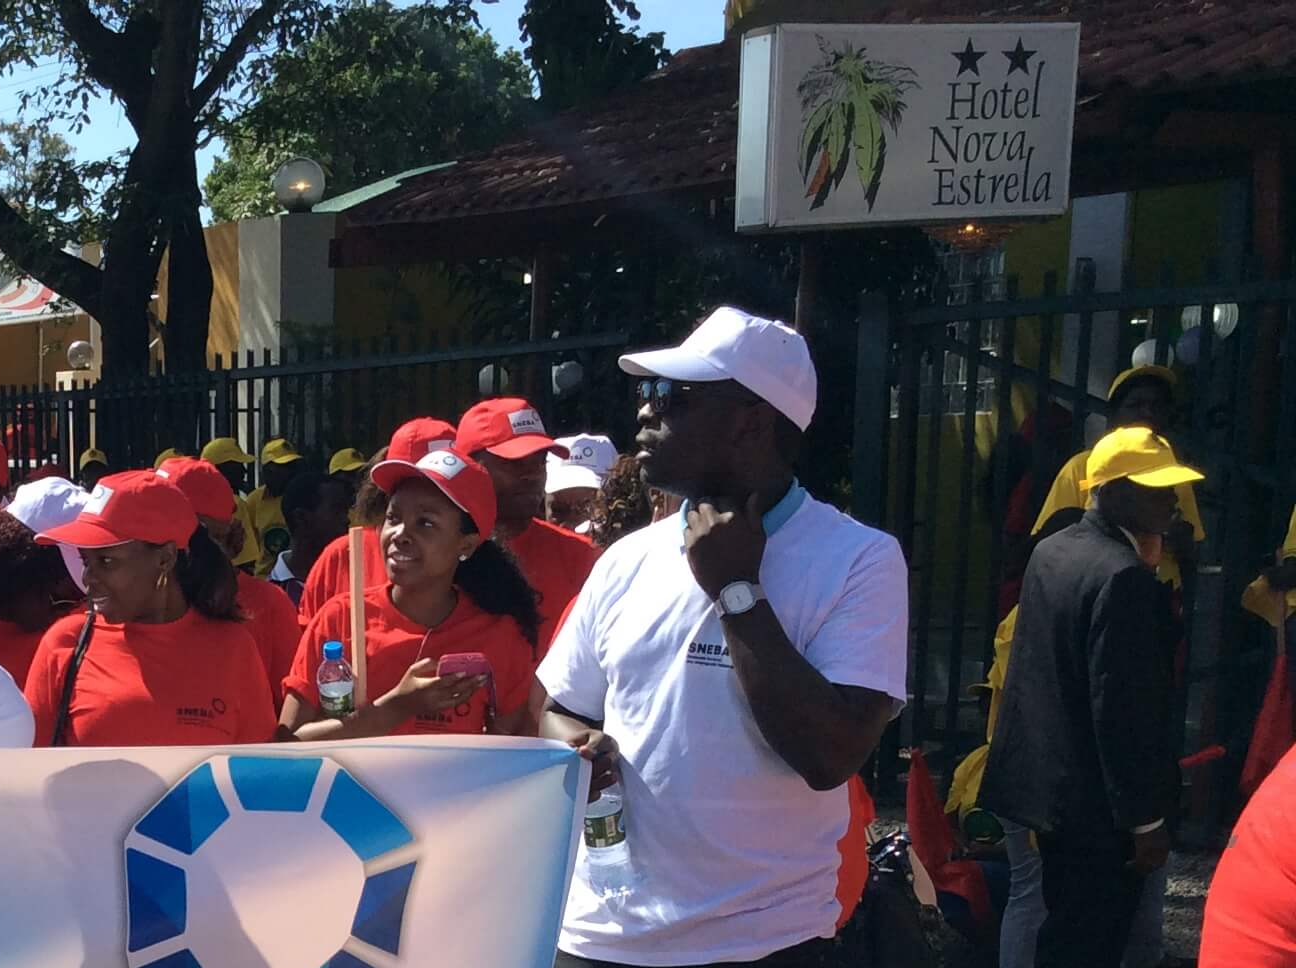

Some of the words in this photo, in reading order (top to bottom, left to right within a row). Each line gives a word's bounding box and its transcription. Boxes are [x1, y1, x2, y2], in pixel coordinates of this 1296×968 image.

[945, 60, 1046, 121] Hotel
[927, 126, 1027, 164] Nova
[931, 146, 1053, 206] Estrela
[688, 641, 730, 657] SNEBA
